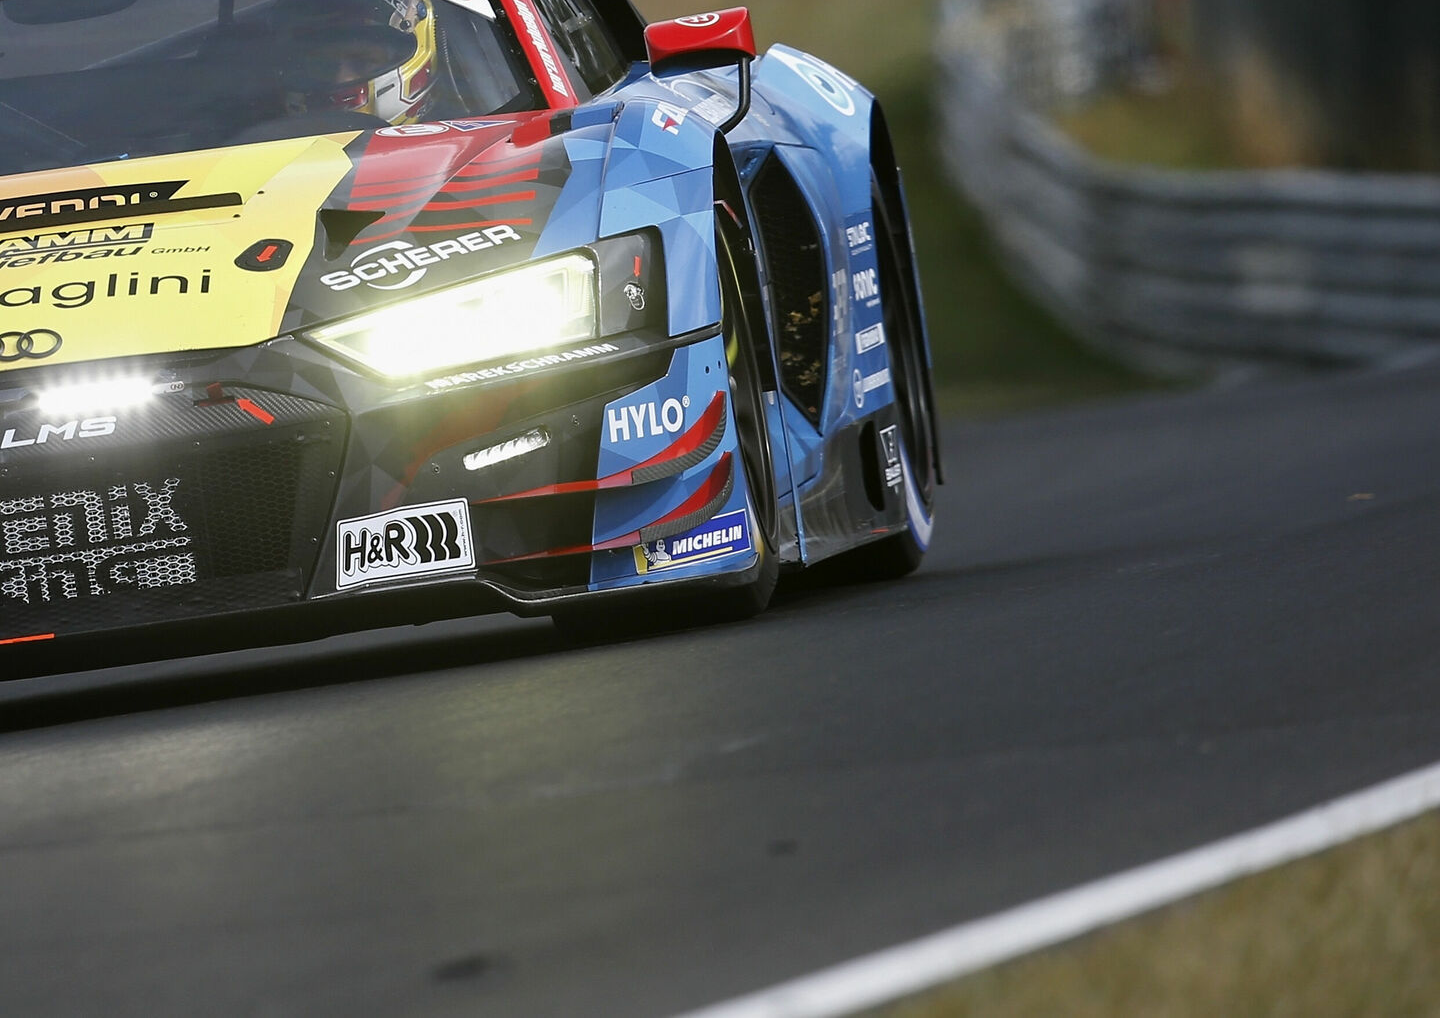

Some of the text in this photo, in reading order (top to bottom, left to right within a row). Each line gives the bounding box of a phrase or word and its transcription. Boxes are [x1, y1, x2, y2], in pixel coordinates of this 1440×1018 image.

[151, 246, 211, 255] GmbH
[320, 224, 522, 291] SCHERER
[424, 343, 620, 390] MAREKSCHRAMM
[0, 416, 117, 450] LMS
[607, 402, 684, 443] HYLO
[343, 521, 418, 577] H&R
[672, 523, 743, 556] MICHELIN
